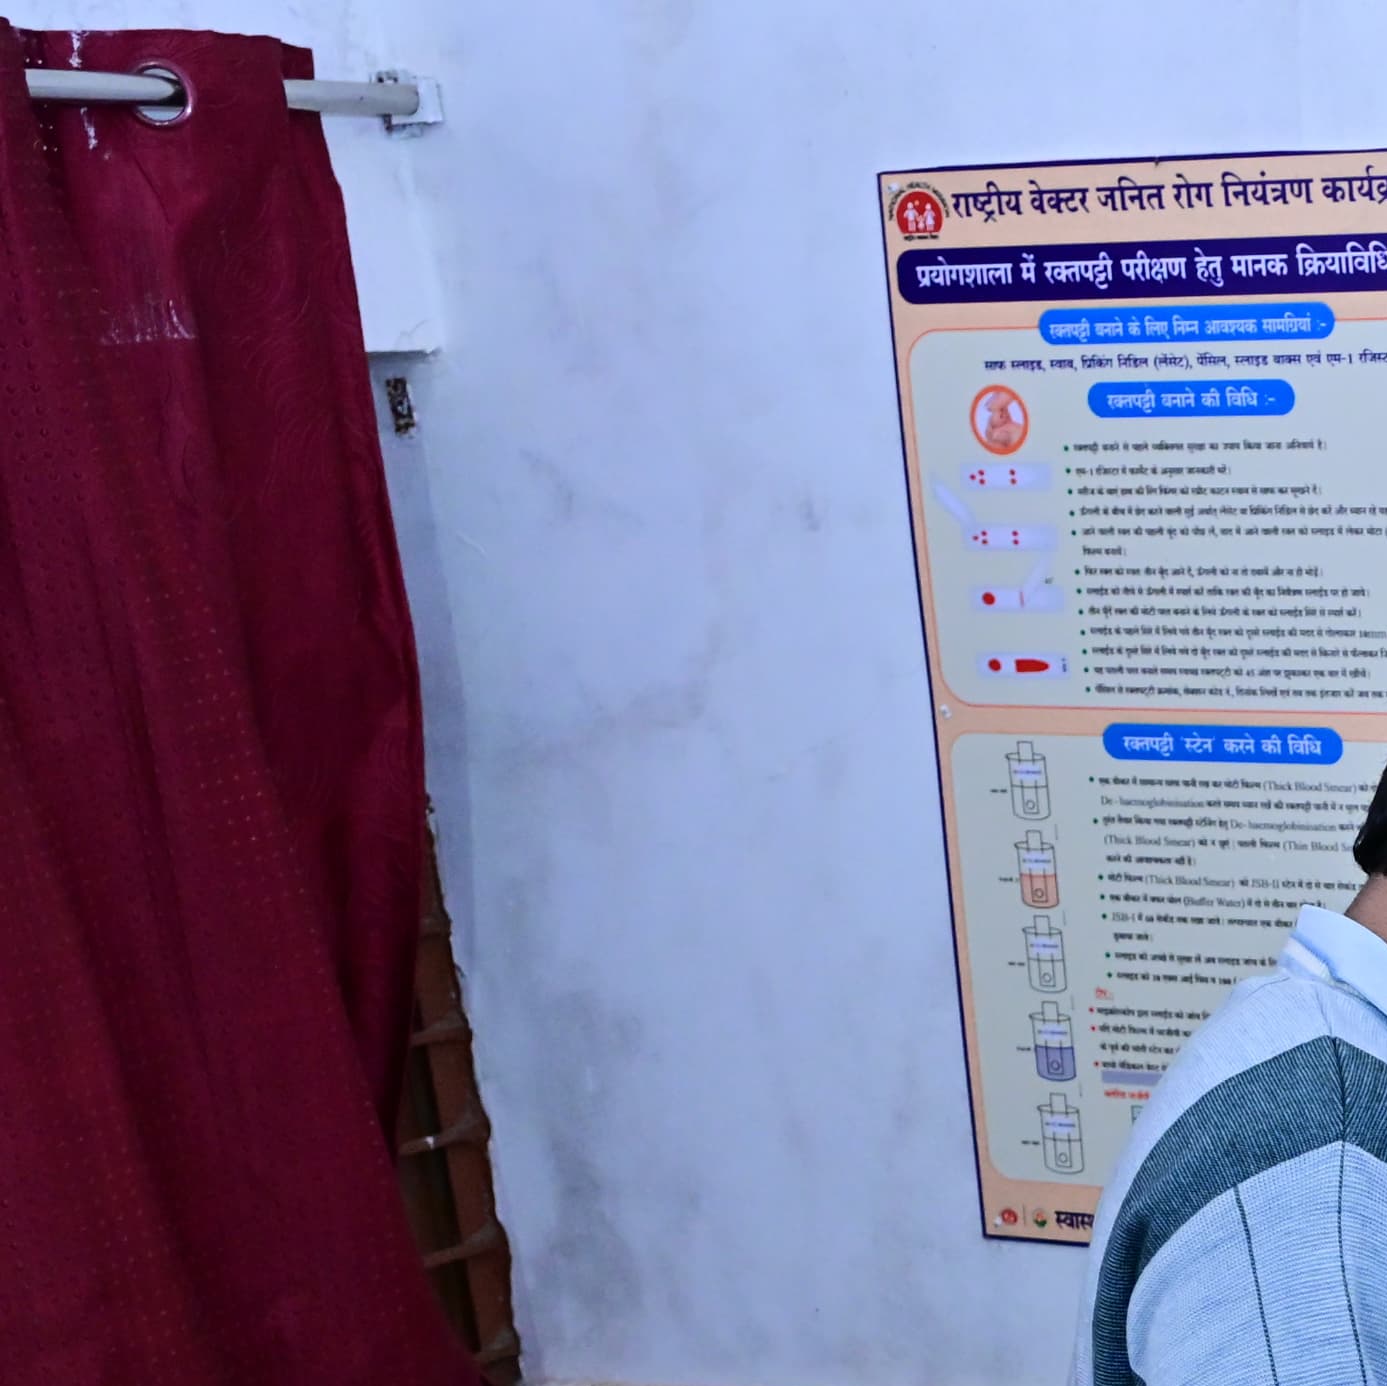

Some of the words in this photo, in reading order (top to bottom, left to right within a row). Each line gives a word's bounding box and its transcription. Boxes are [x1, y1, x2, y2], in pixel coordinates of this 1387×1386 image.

[951, 181, 1022, 222] राष्ट्रीय
[1029, 180, 1089, 214] वेक्टर
[1096, 176, 1165, 211] जनित
[1172, 173, 1213, 208] रोग
[1221, 171, 1313, 206] नियंत्रण
[916, 256, 1012, 287] प्रयोगशाला
[1020, 253, 1036, 283] में
[1043, 252, 1113, 289] रक्तपट्टी
[1120, 250, 1186, 283] परीक्षण
[1194, 247, 1224, 287] हेतु
[1230, 254, 1288, 276] मानक
[1128, 316, 1141, 336] के
[1145, 315, 1170, 340] लिए
[1200, 386, 1221, 408] की
[1225, 384, 1258, 407] विधि
[1121, 733, 1174, 758] रक्तपट्टी
[1223, 734, 1255, 756] करने
[1260, 733, 1282, 756] की
[1286, 733, 1322, 757] विधि
